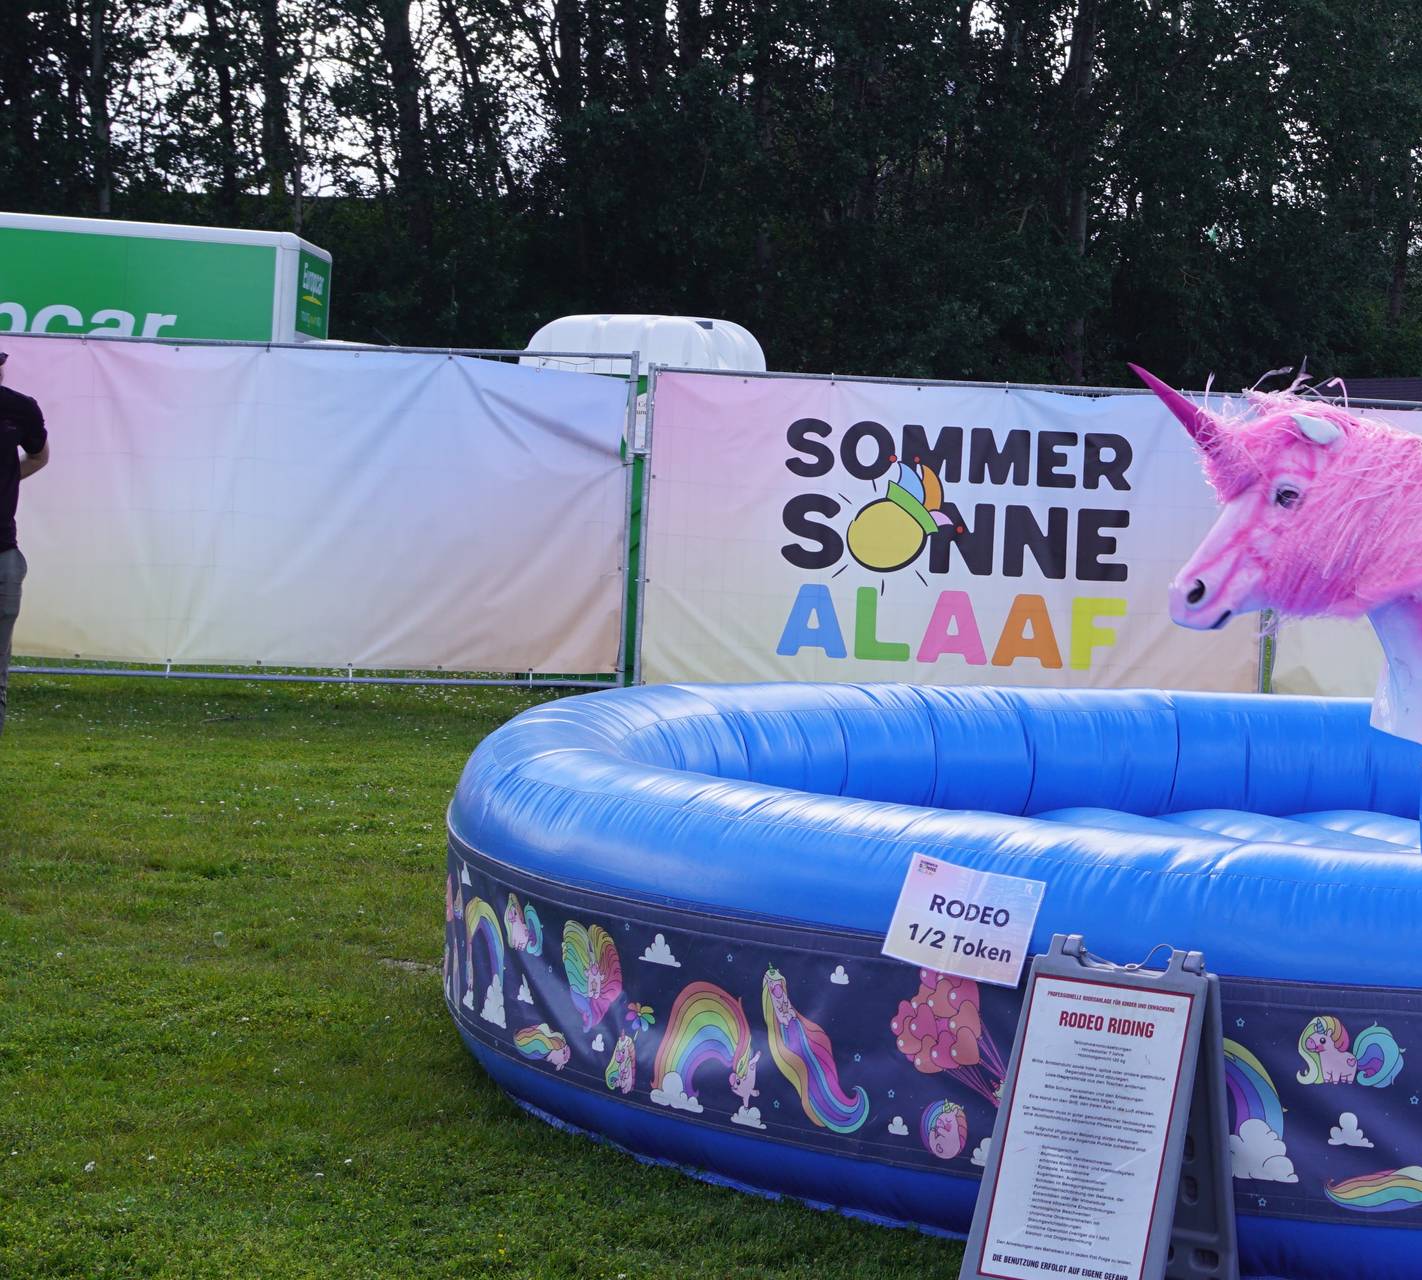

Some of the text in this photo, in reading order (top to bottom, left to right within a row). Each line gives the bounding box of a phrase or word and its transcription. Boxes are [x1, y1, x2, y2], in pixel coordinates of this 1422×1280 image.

[785, 417, 1133, 491] SOMMER
[776, 583, 1128, 671] ALAAF
[929, 894, 1010, 928] RODEO
[909, 923, 1012, 964] 1/2 Token
[1059, 1011, 1155, 1038] RODEO RIDING
[992, 1254, 1002, 1262] DIE
[1004, 1256, 1039, 1268] BENUTZUNG
[1041, 1262, 1067, 1272] ERFOLGT
[1082, 1269, 1103, 1280] EIGENE
